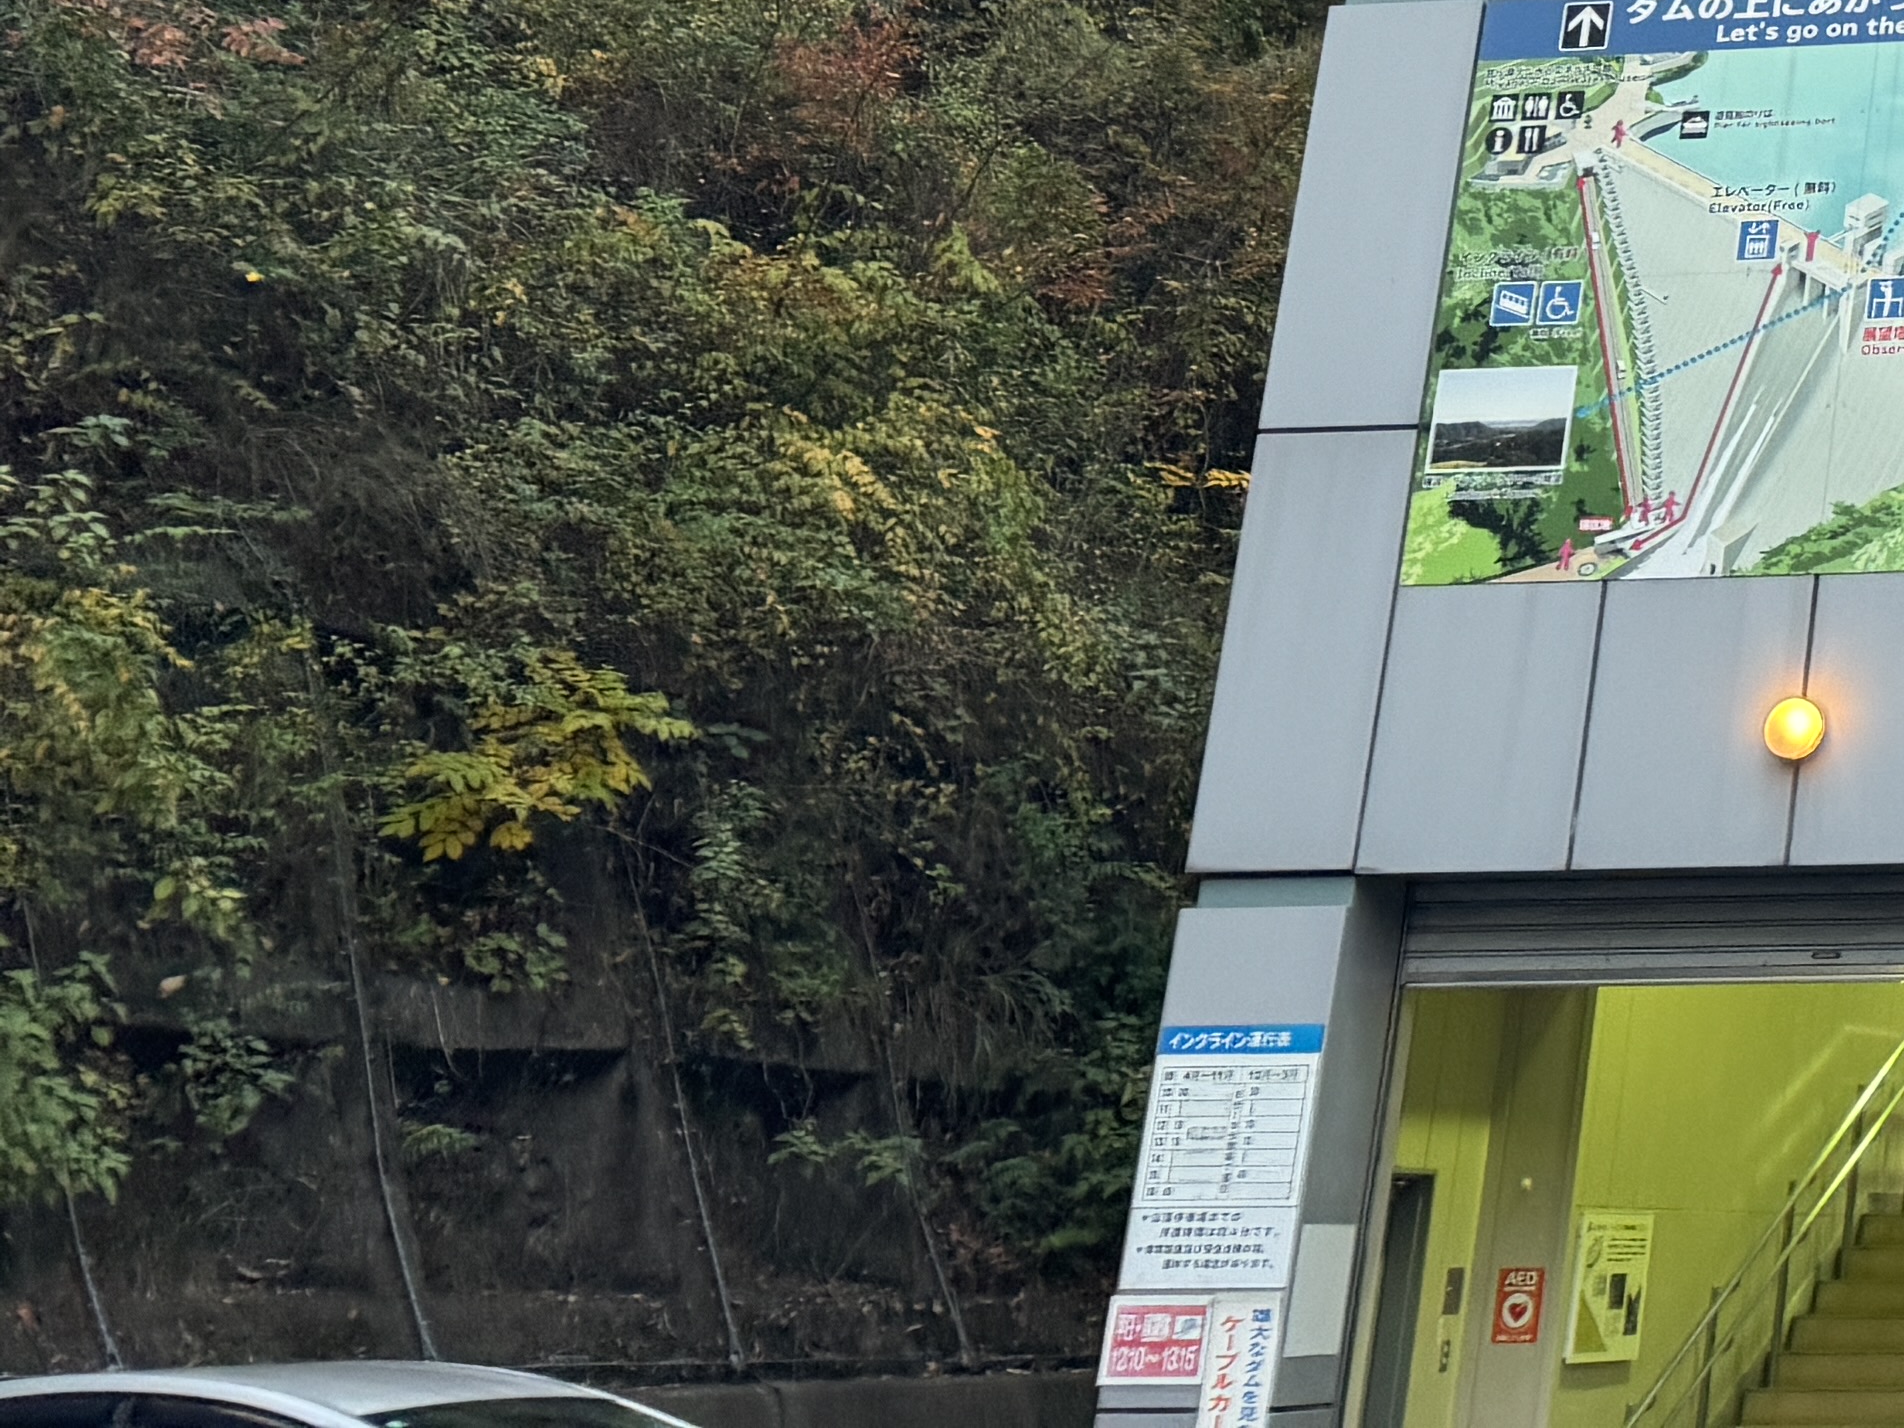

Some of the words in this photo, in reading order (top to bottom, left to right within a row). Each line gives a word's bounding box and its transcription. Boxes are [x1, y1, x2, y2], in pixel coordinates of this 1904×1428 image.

[1716, 22, 1780, 43] Let's
[1786, 24, 1819, 43] go
[1826, 22, 1858, 38] on
[1504, 1270, 1538, 1286] AED
